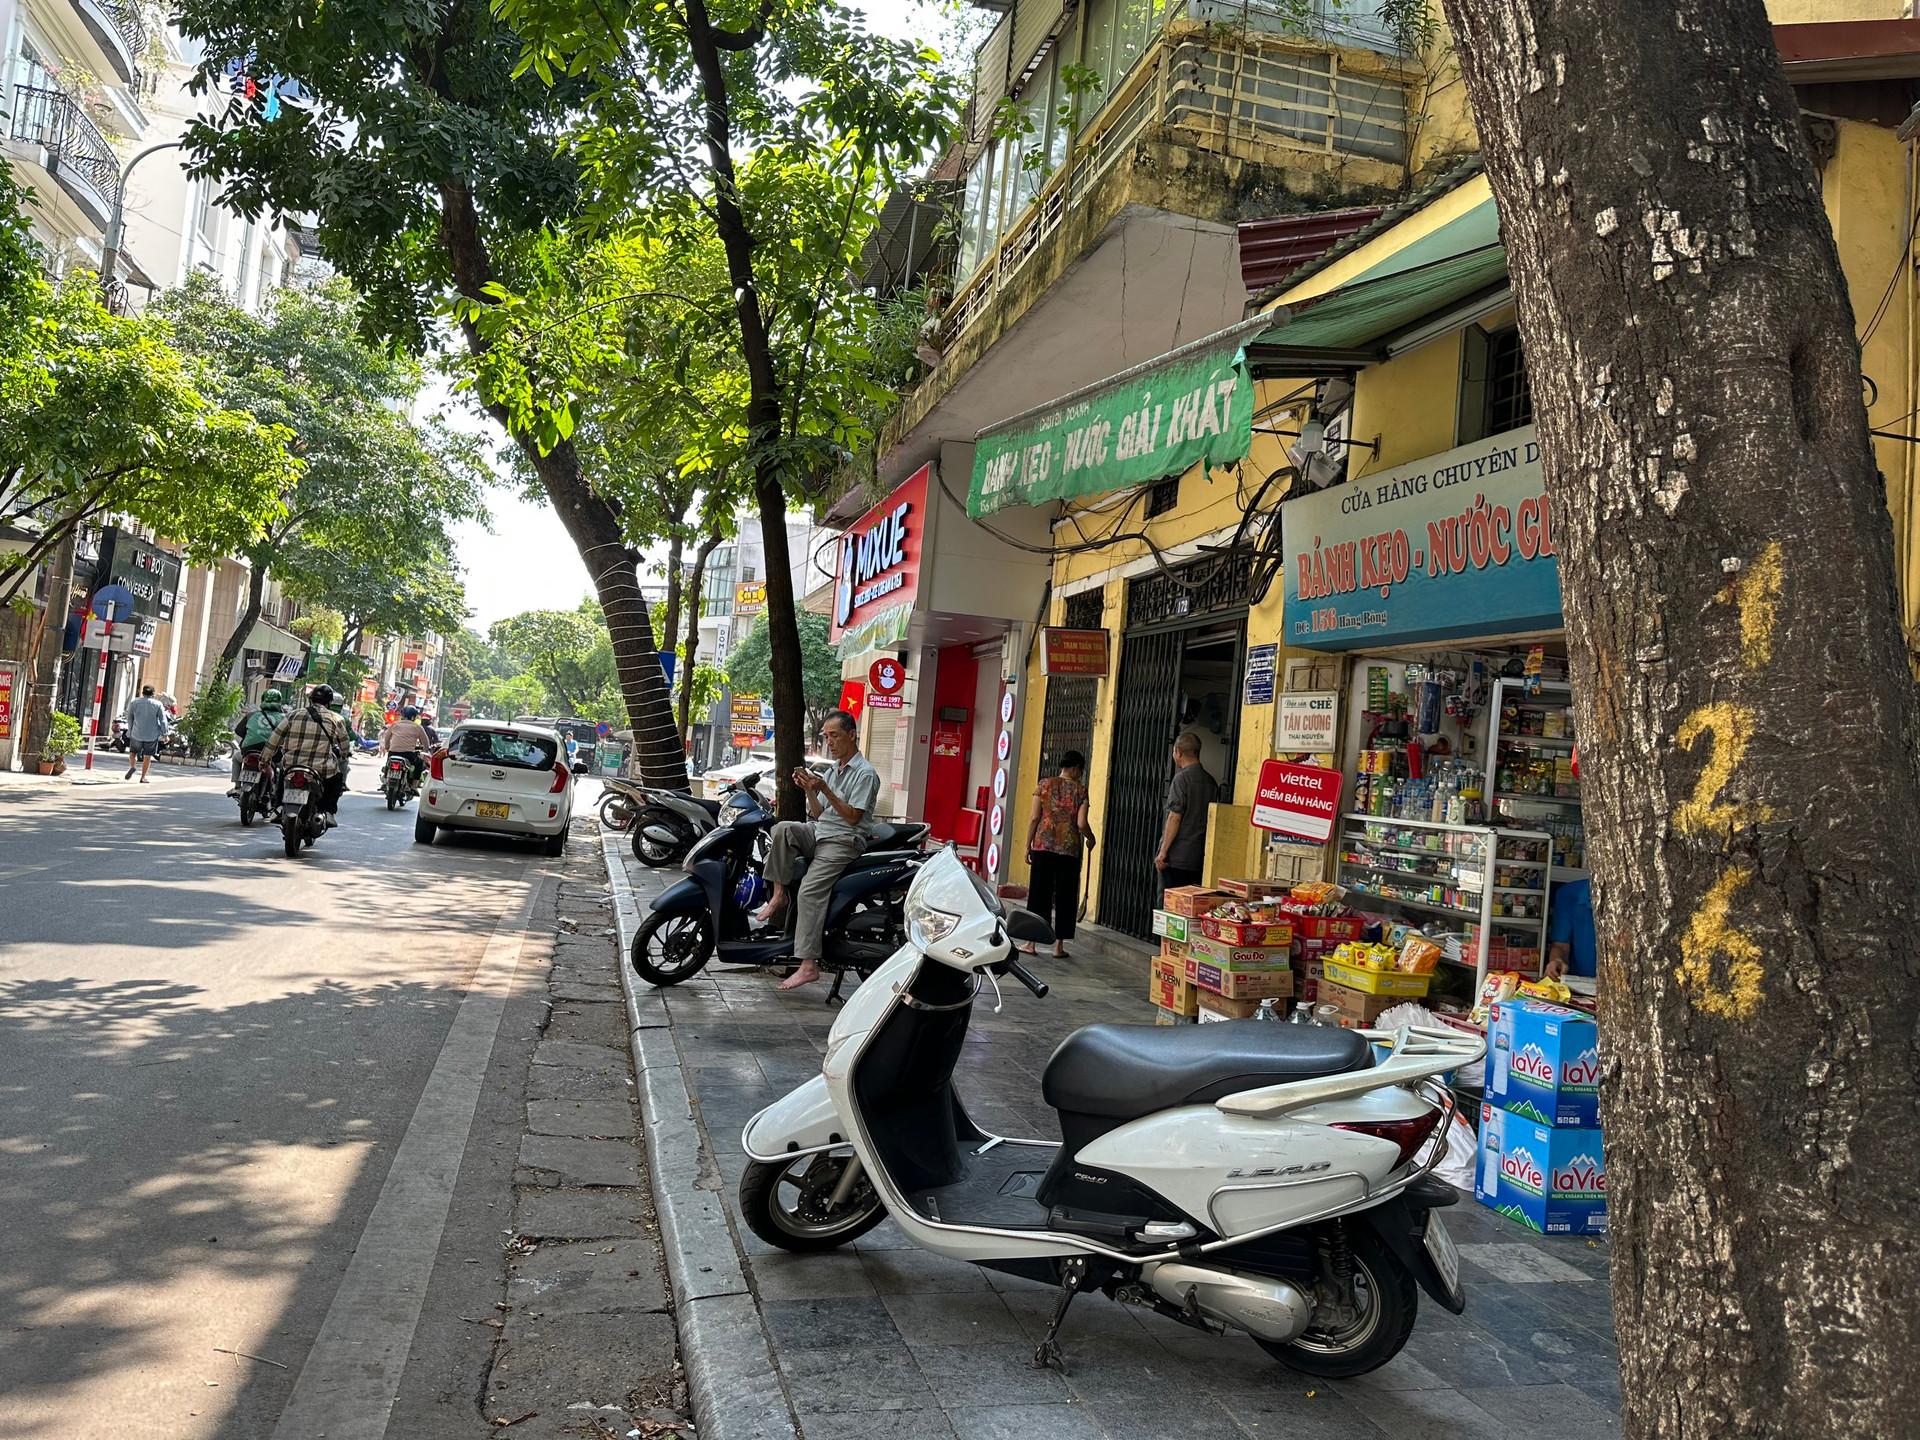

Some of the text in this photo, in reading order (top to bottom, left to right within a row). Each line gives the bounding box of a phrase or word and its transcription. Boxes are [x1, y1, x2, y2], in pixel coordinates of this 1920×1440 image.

[1063, 414, 1111, 475] NƯỚC
[1116, 392, 1162, 460] GIẢI
[1166, 369, 1237, 448] KHÁT
[1342, 485, 1372, 513] CỬA
[1376, 475, 1428, 505] HÀNG
[1433, 447, 1518, 488] CHUYÊN
[855, 502, 907, 587] MIXUE
[1297, 536, 1356, 600] BÁNH
[1360, 528, 1410, 599] KẸO
[1427, 492, 1509, 577] NƯỚC
[117, 576, 148, 598] CONVERSE
[1311, 608, 1337, 633] 156
[1339, 614, 1361, 630] Hàng
[869, 695, 887, 703] SINCE
[1309, 697, 1333, 710] CHÈ
[1283, 712, 1301, 731] TÂN
[1280, 772, 1323, 790] viettel
[1260, 786, 1333, 811] ĐIỂM BÁN HÀNG
[1511, 1051, 1553, 1079] laVie
[1226, 1161, 1331, 1178] LEAD
[1501, 1152, 1543, 1187] laVie
